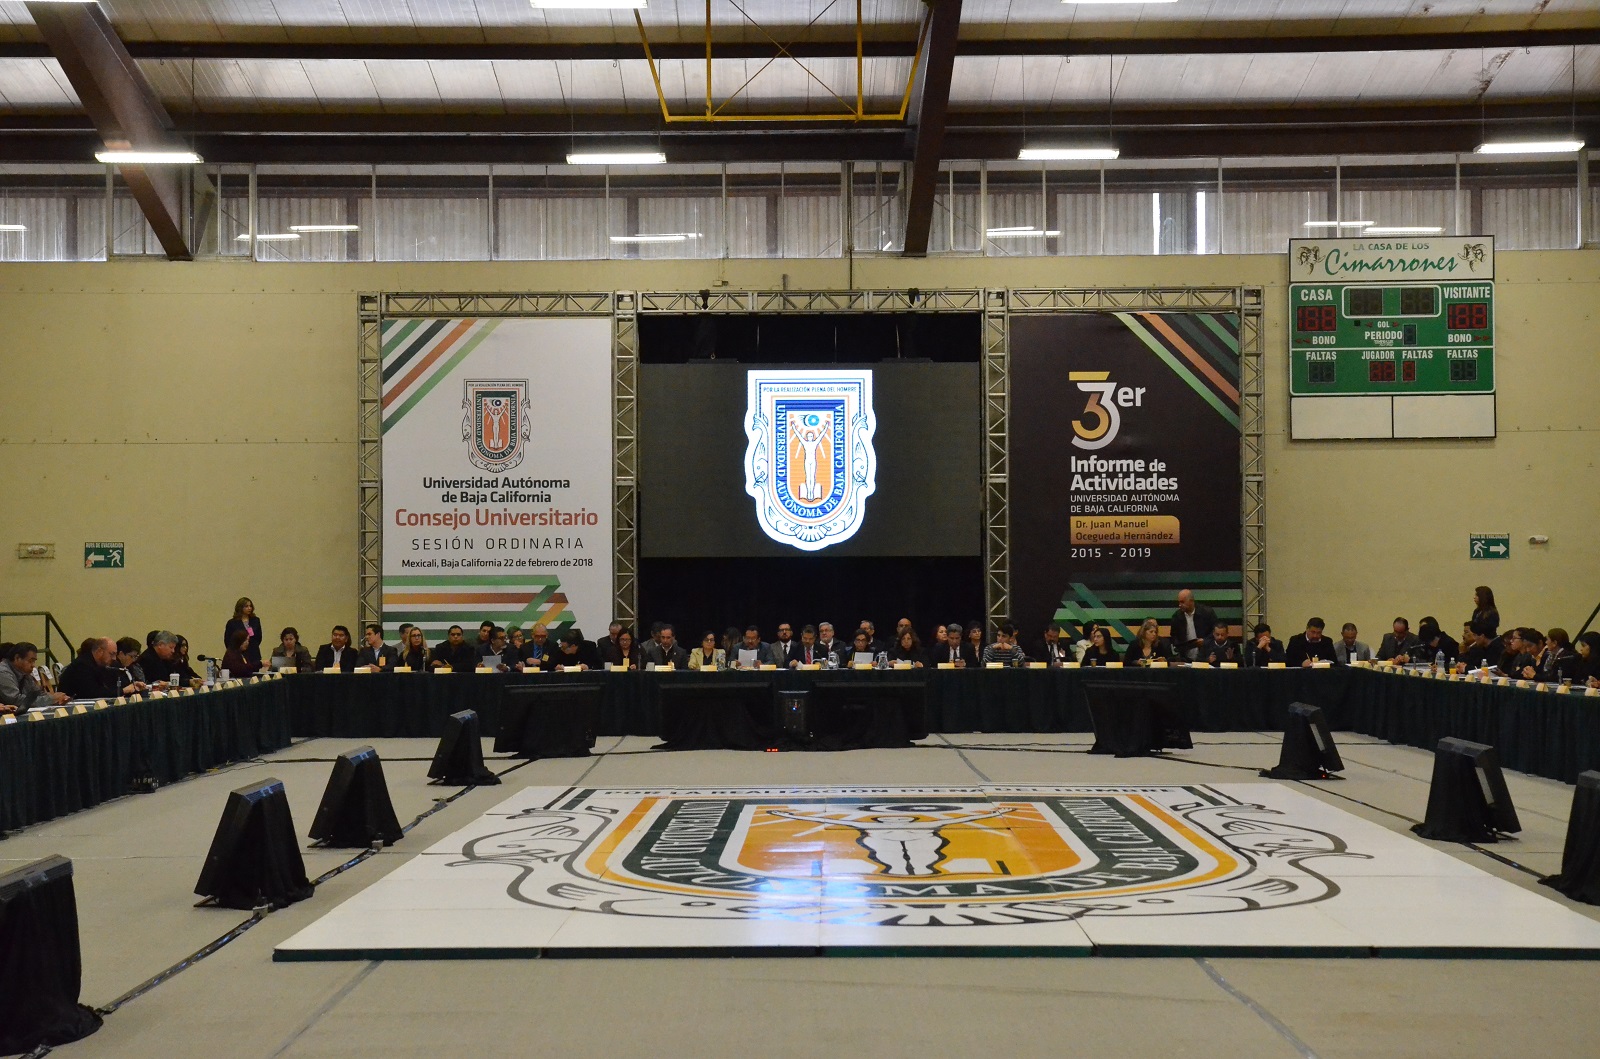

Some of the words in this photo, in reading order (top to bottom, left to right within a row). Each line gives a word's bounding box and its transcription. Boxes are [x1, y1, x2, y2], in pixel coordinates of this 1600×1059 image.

[1325, 248, 1458, 275] Cimarrones
[1300, 289, 1333, 301] CASA
[1443, 287, 1490, 299] VISITANTE
[1312, 336, 1336, 345] BONO
[1364, 331, 1402, 340] PERIODO
[1448, 334, 1472, 342] BONO
[1306, 352, 1337, 360] FALTAS
[1362, 351, 1395, 360] JUGADOR
[1402, 350, 1433, 359] FALTAS
[1447, 350, 1478, 358] FALTAS
[776, 404, 786, 477] UNIVERSIDAD
[835, 404, 844, 468] CALIFORNIA
[1070, 455, 1145, 472] Informe
[1149, 459, 1166, 472] de
[423, 477, 499, 488] Universidad
[501, 476, 570, 488] Autónoma
[834, 472, 844, 496] BAJA
[1070, 473, 1178, 491] Actividades
[442, 492, 457, 503] de
[460, 492, 487, 505] Baja
[490, 491, 551, 503] California
[1070, 494, 1128, 502] UNIVERSIDAD
[1131, 493, 1180, 501] AUTÓNOMA
[824, 497, 838, 512] DE
[1085, 505, 1105, 514] BAJA
[395, 508, 471, 530] Consejo
[476, 508, 598, 526] Universitario
[1090, 520, 1111, 529] Juan
[1114, 520, 1148, 528] Manuel
[412, 536, 474, 550] SESIÓN
[485, 537, 584, 550] ORDINARIA
[1076, 532, 1120, 542] Ocegueda
[1124, 532, 1173, 540] Hernández
[1071, 548, 1101, 558] 2015
[1120, 548, 1151, 558] 2019
[402, 559, 439, 569] Mexicali,
[441, 559, 460, 569] Baja
[461, 559, 502, 567] California
[504, 559, 514, 567] 22
[516, 559, 526, 567] de
[528, 559, 559, 567] febrero
[560, 559, 571, 567] de
[572, 559, 593, 567] 2018
[1057, 798, 1154, 844] CALIFORNIA
[650, 801, 730, 854] UNIVERSIDAD
[1108, 846, 1185, 871] BAJA
[1036, 872, 1152, 888] DE
